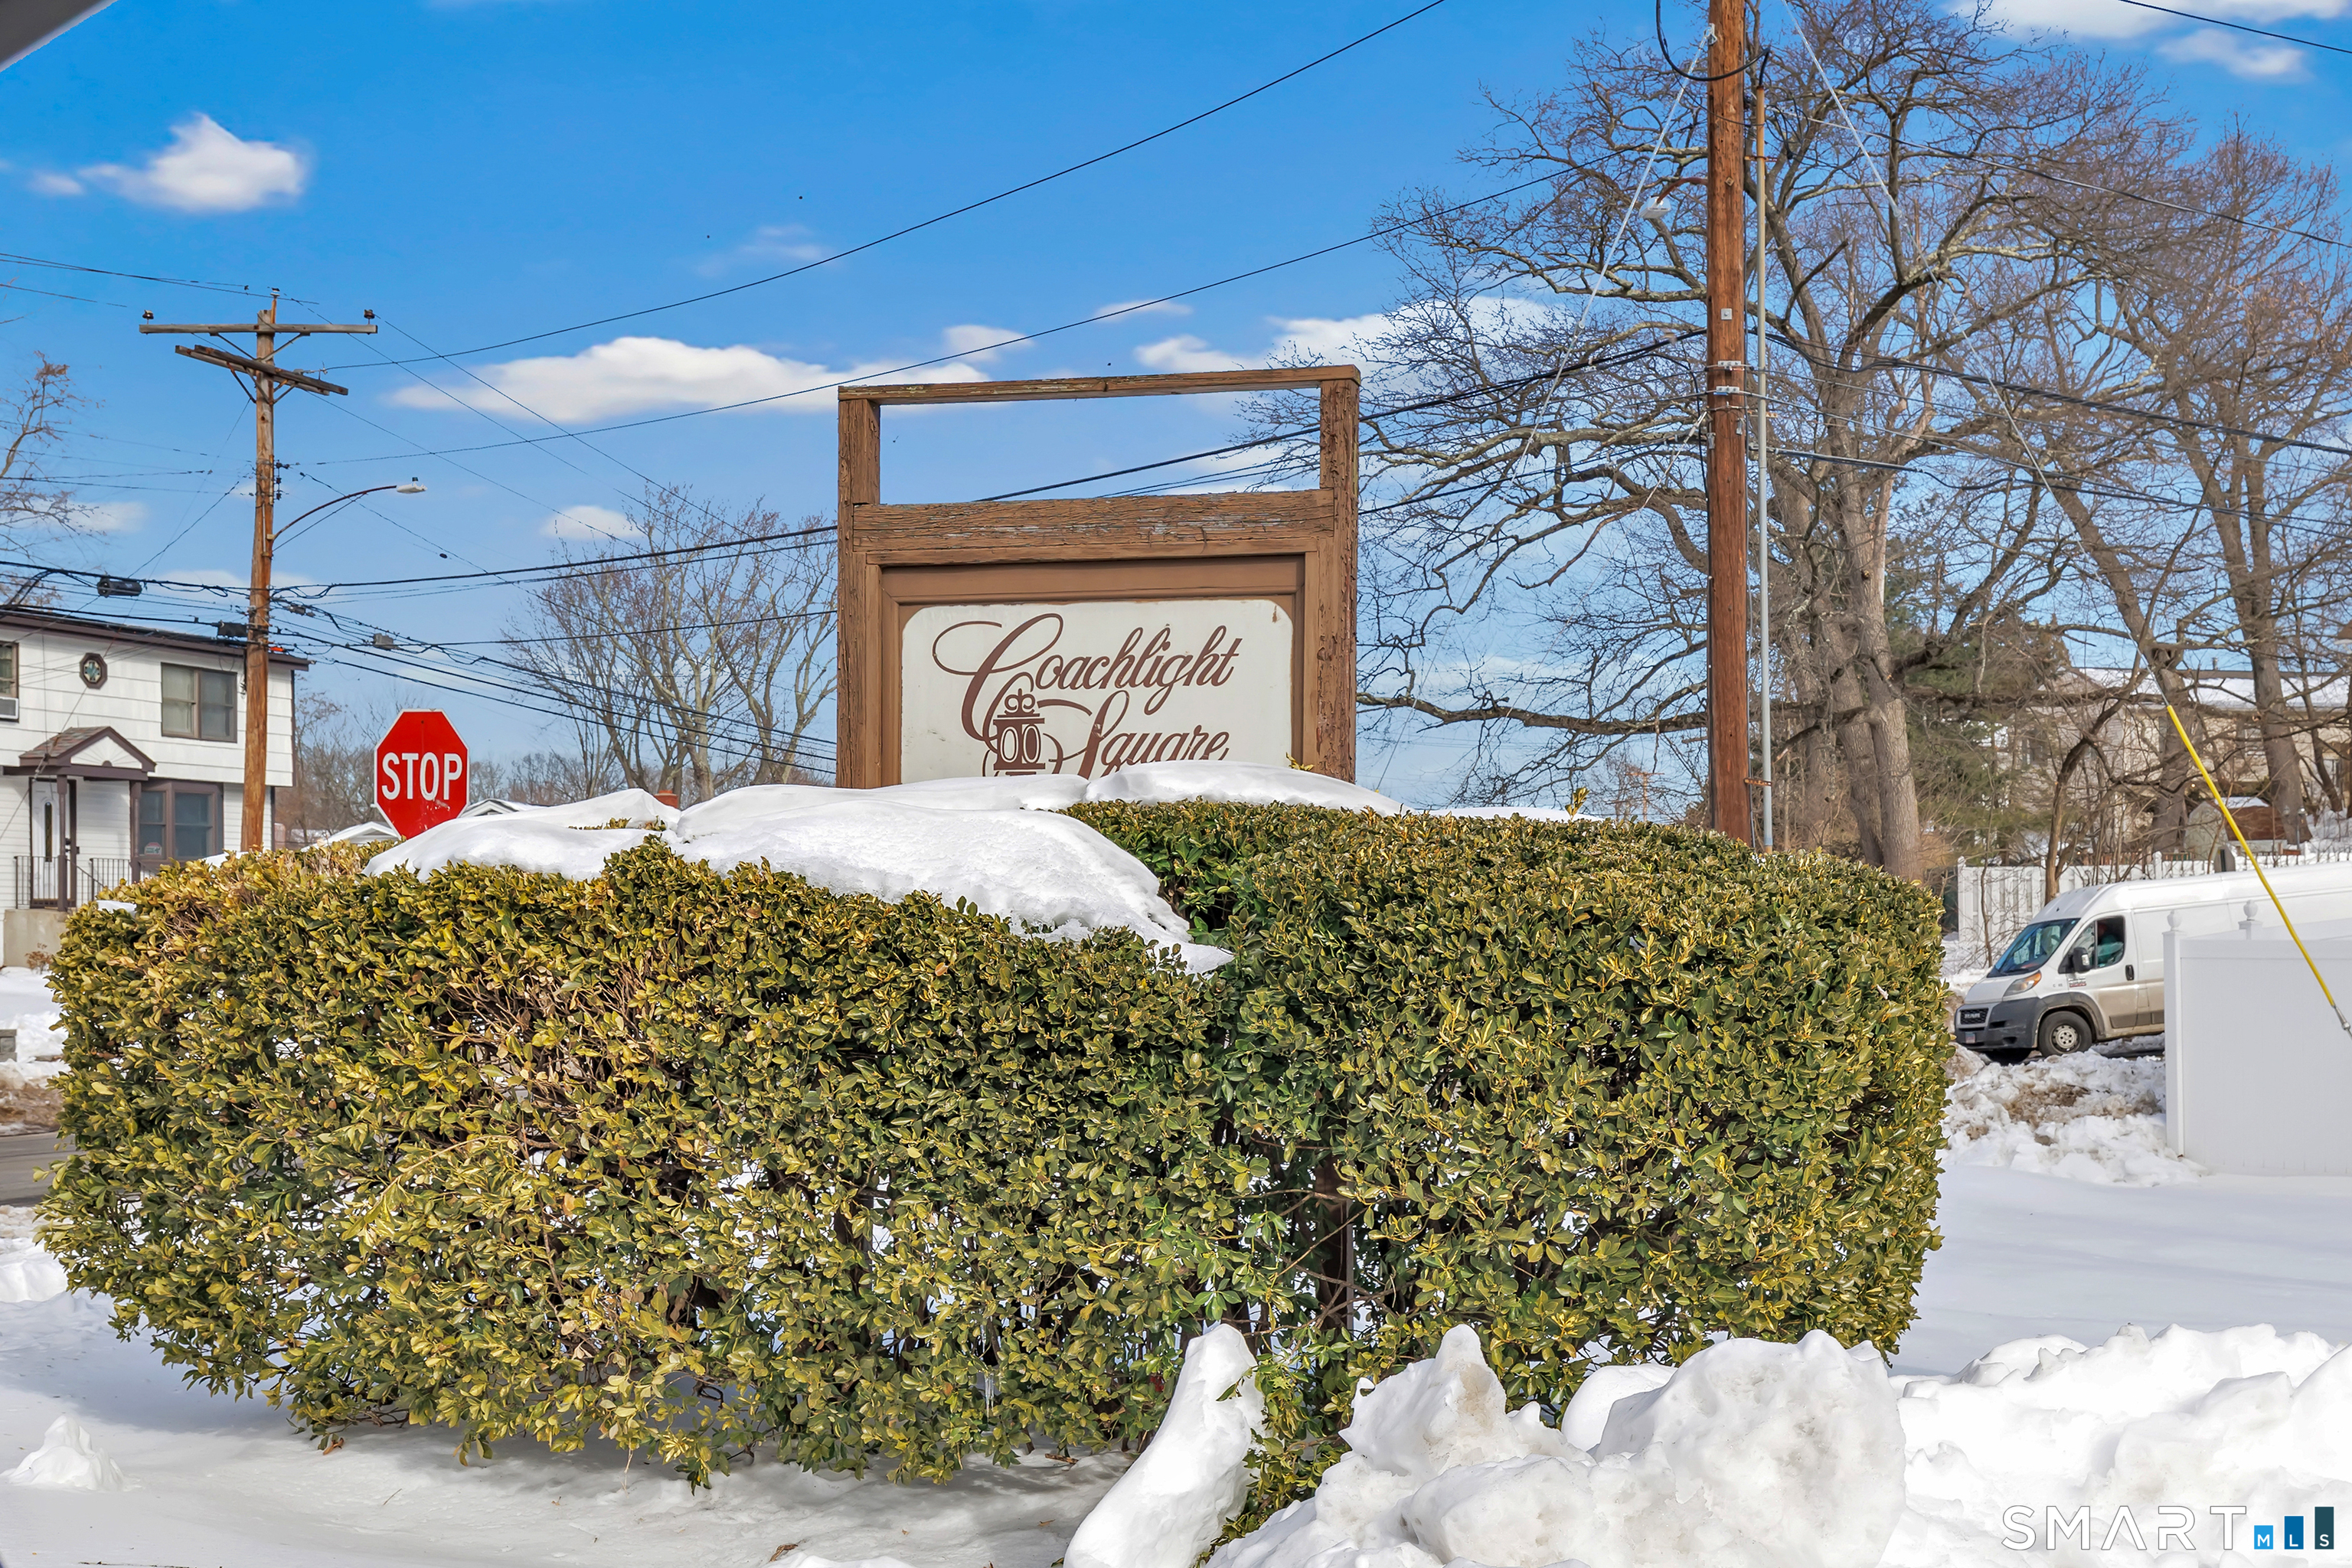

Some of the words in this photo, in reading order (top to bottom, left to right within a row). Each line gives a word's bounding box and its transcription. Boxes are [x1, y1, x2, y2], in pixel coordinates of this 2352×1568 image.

[933, 612, 1243, 741] Coachlight
[381, 752, 463, 801] STOP
[1037, 689, 1230, 780] Square
